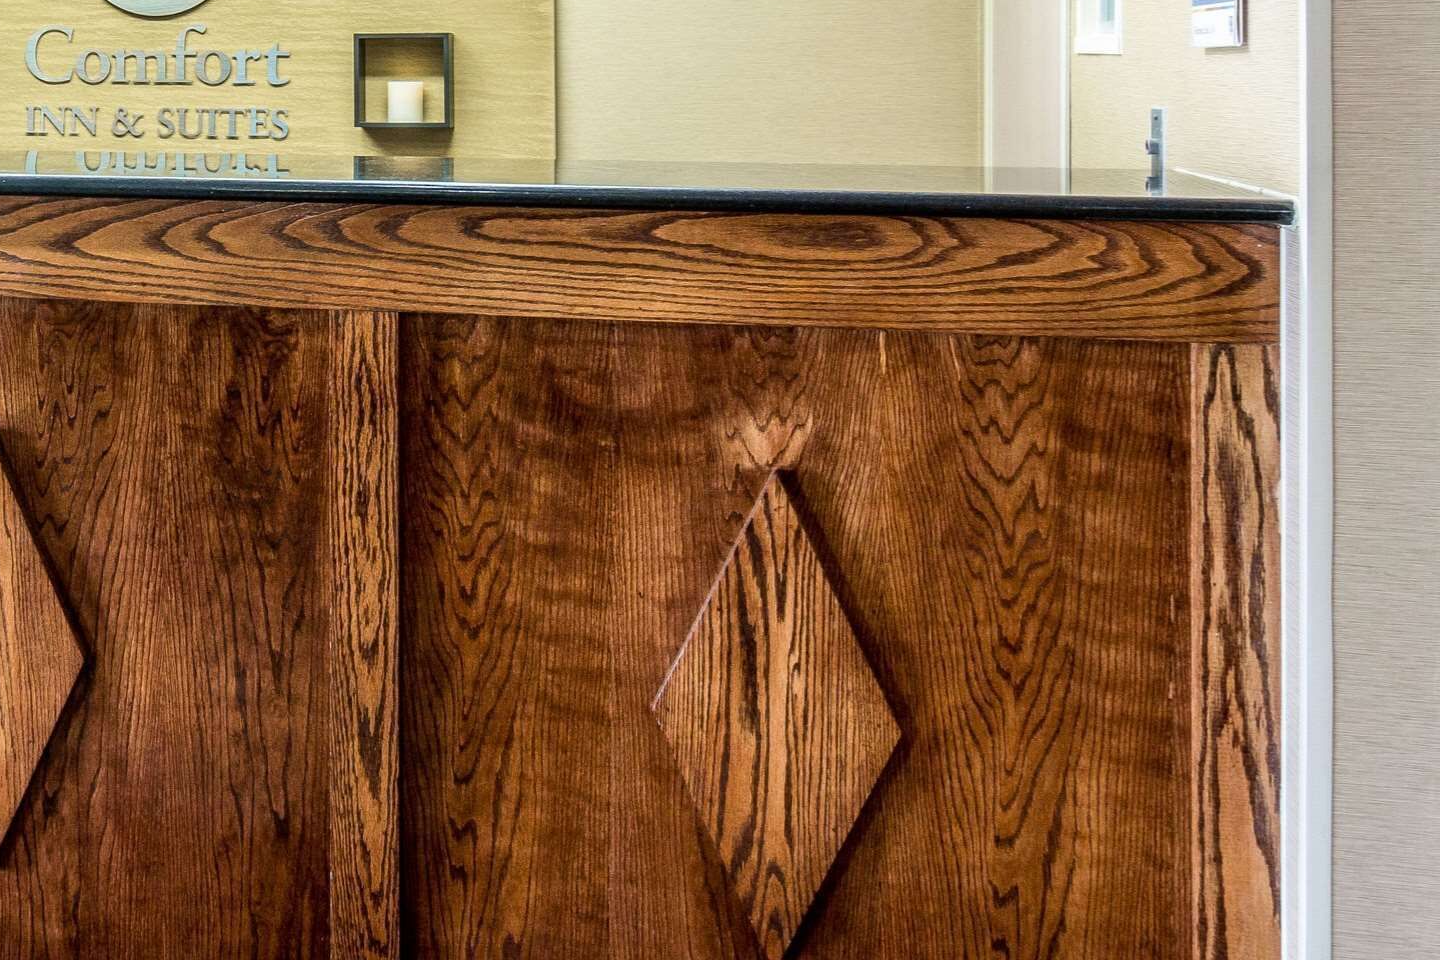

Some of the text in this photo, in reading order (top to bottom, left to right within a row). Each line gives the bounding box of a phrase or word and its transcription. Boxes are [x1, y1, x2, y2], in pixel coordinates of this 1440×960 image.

[24, 22, 292, 87] Comfort
[25, 105, 290, 142] INN & SUITES
